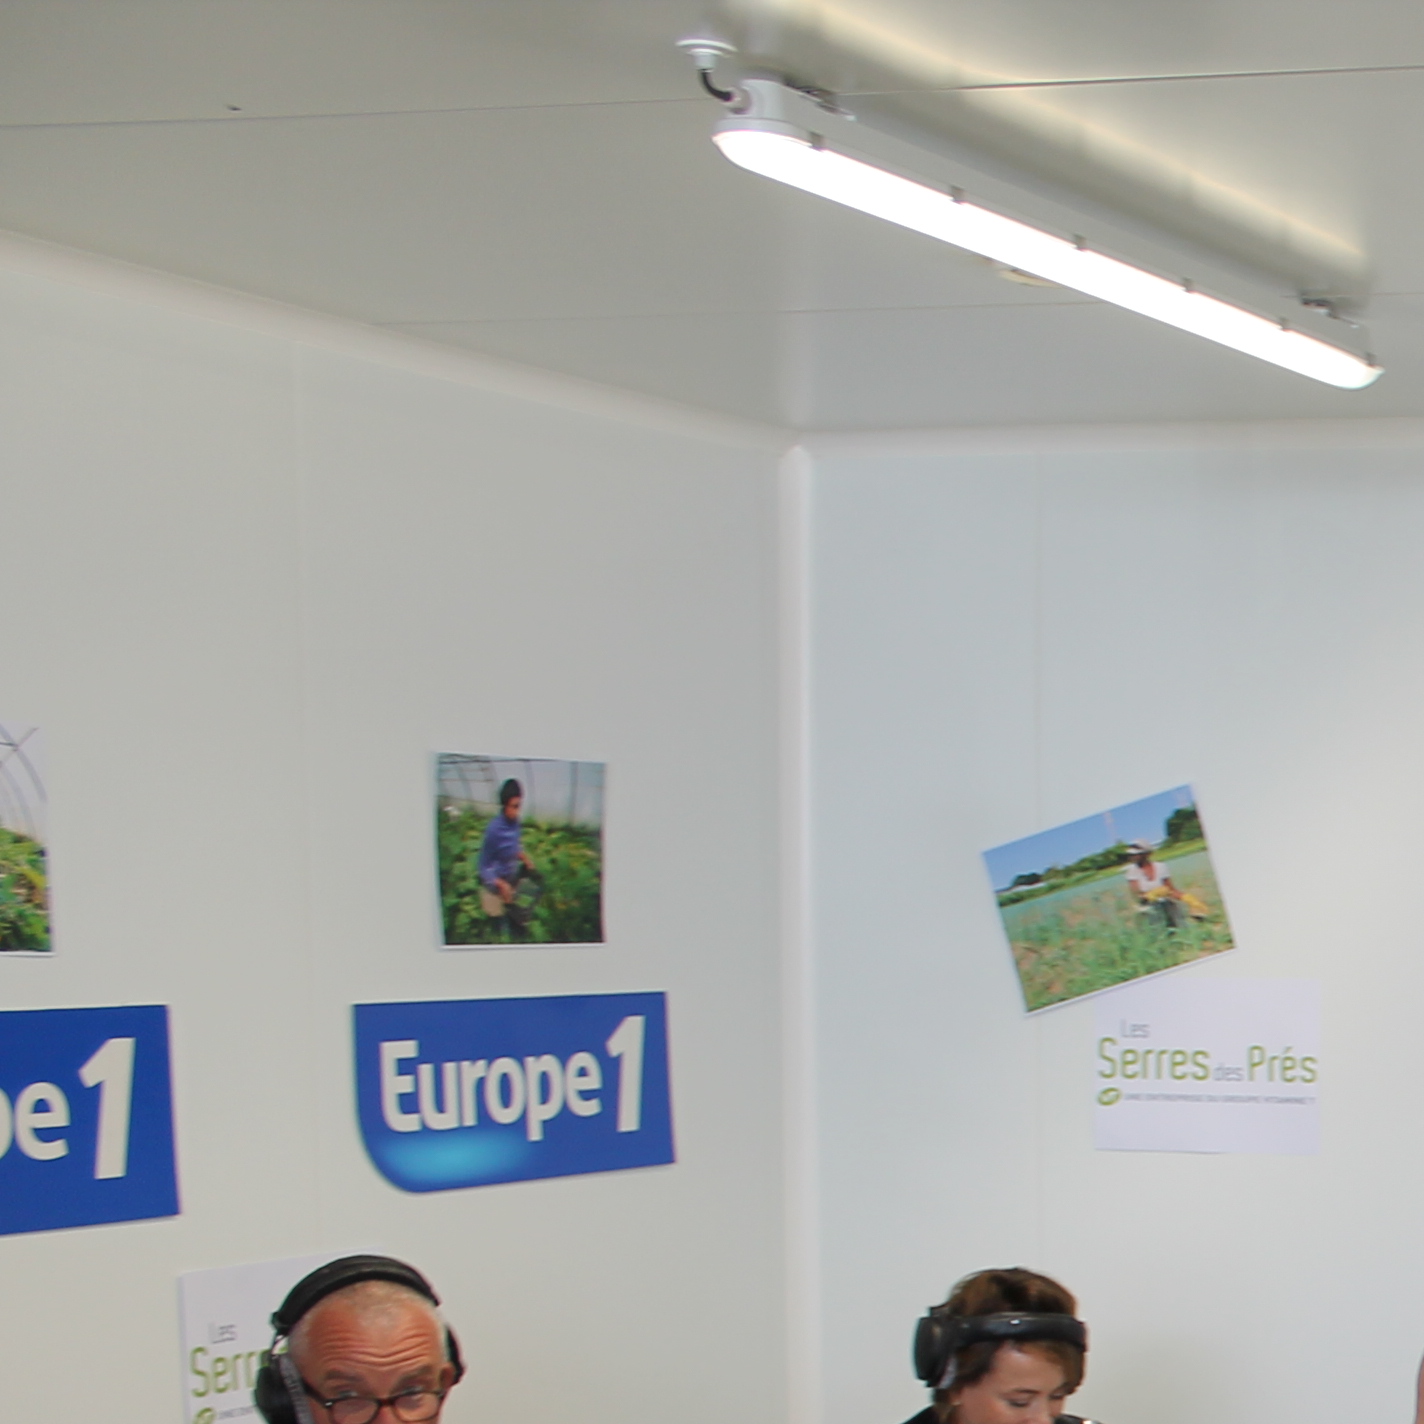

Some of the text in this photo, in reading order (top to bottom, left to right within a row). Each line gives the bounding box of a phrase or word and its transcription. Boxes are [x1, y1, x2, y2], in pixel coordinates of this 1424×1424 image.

[1120, 1019, 1150, 1039] Les
[379, 1014, 645, 1142] Europe 1
[1097, 1036, 1319, 1084] Serres des Prés
[78, 1037, 136, 1180] 1
[190, 1345, 274, 1398] Serr
